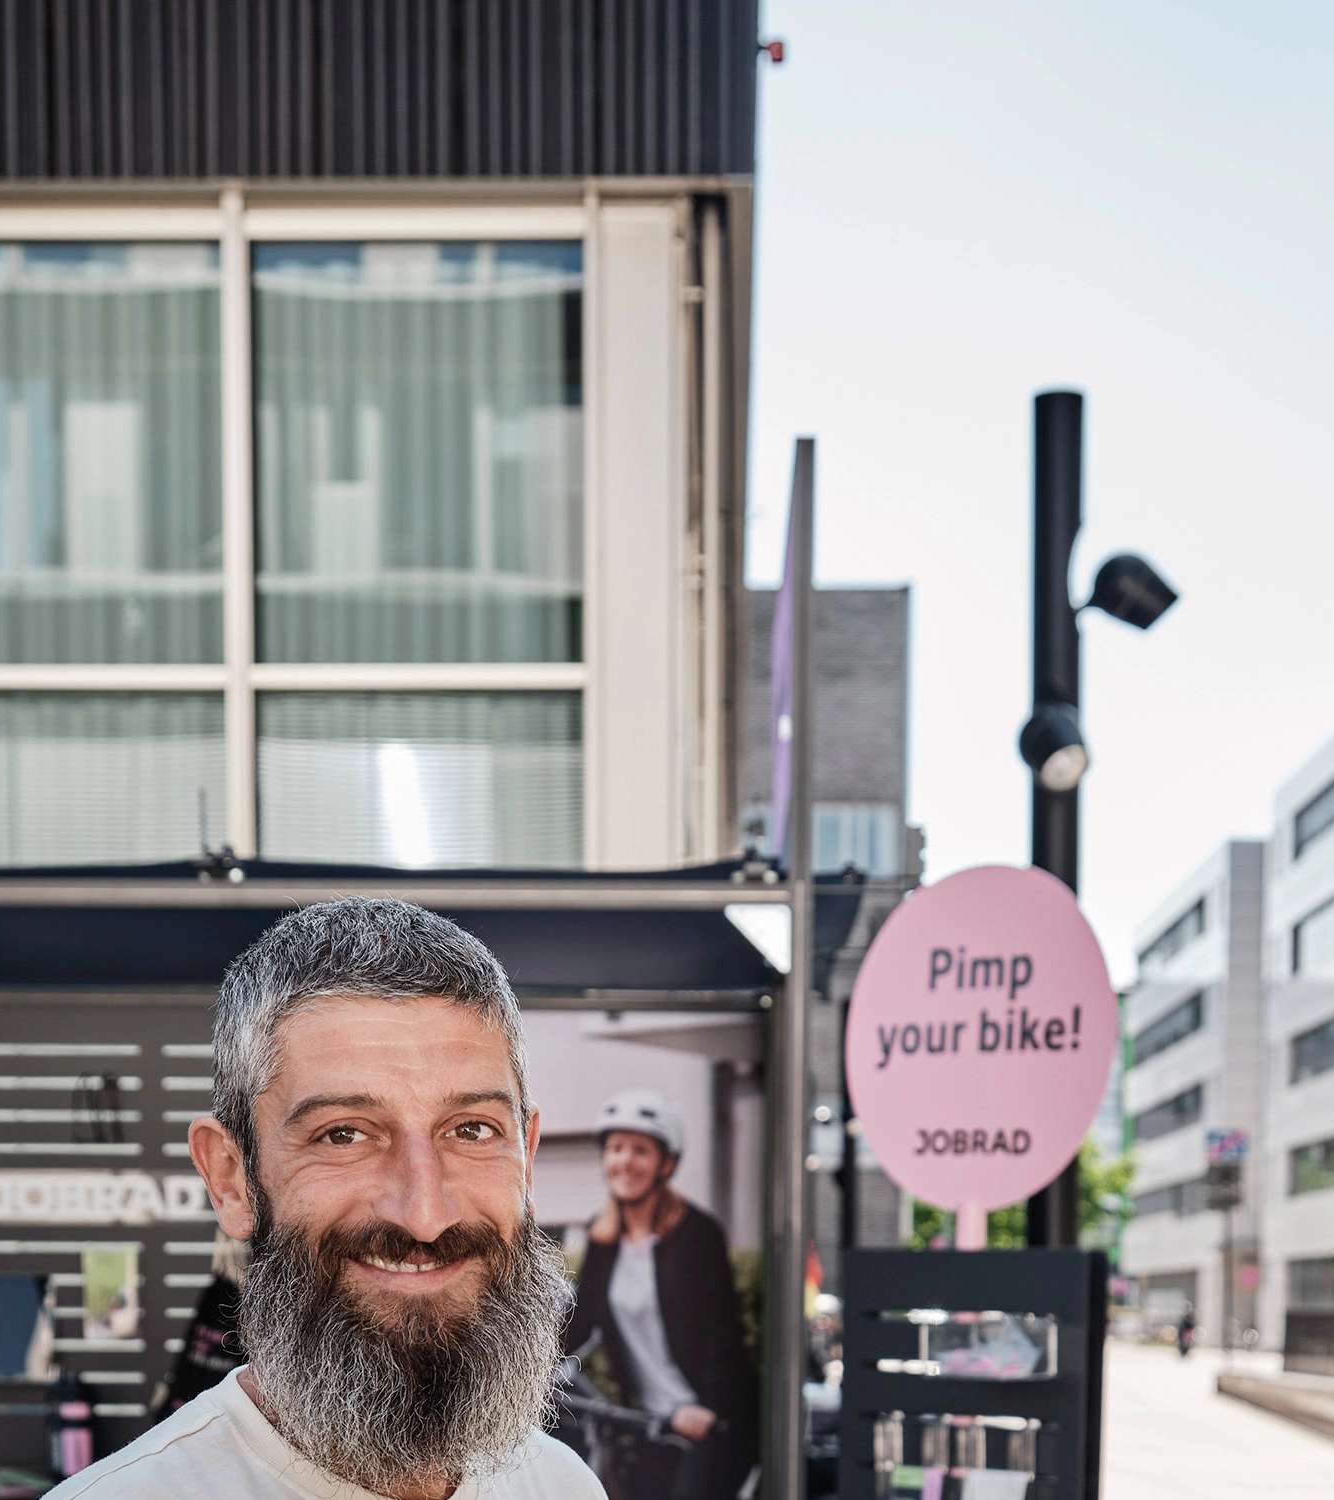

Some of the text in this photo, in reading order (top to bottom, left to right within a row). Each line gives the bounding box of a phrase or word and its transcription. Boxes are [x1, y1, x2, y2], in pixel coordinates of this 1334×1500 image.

[929, 947, 1034, 1000] Pimp
[876, 1004, 1082, 1070] your bike!
[914, 1129, 1031, 1155] JOBRAD
